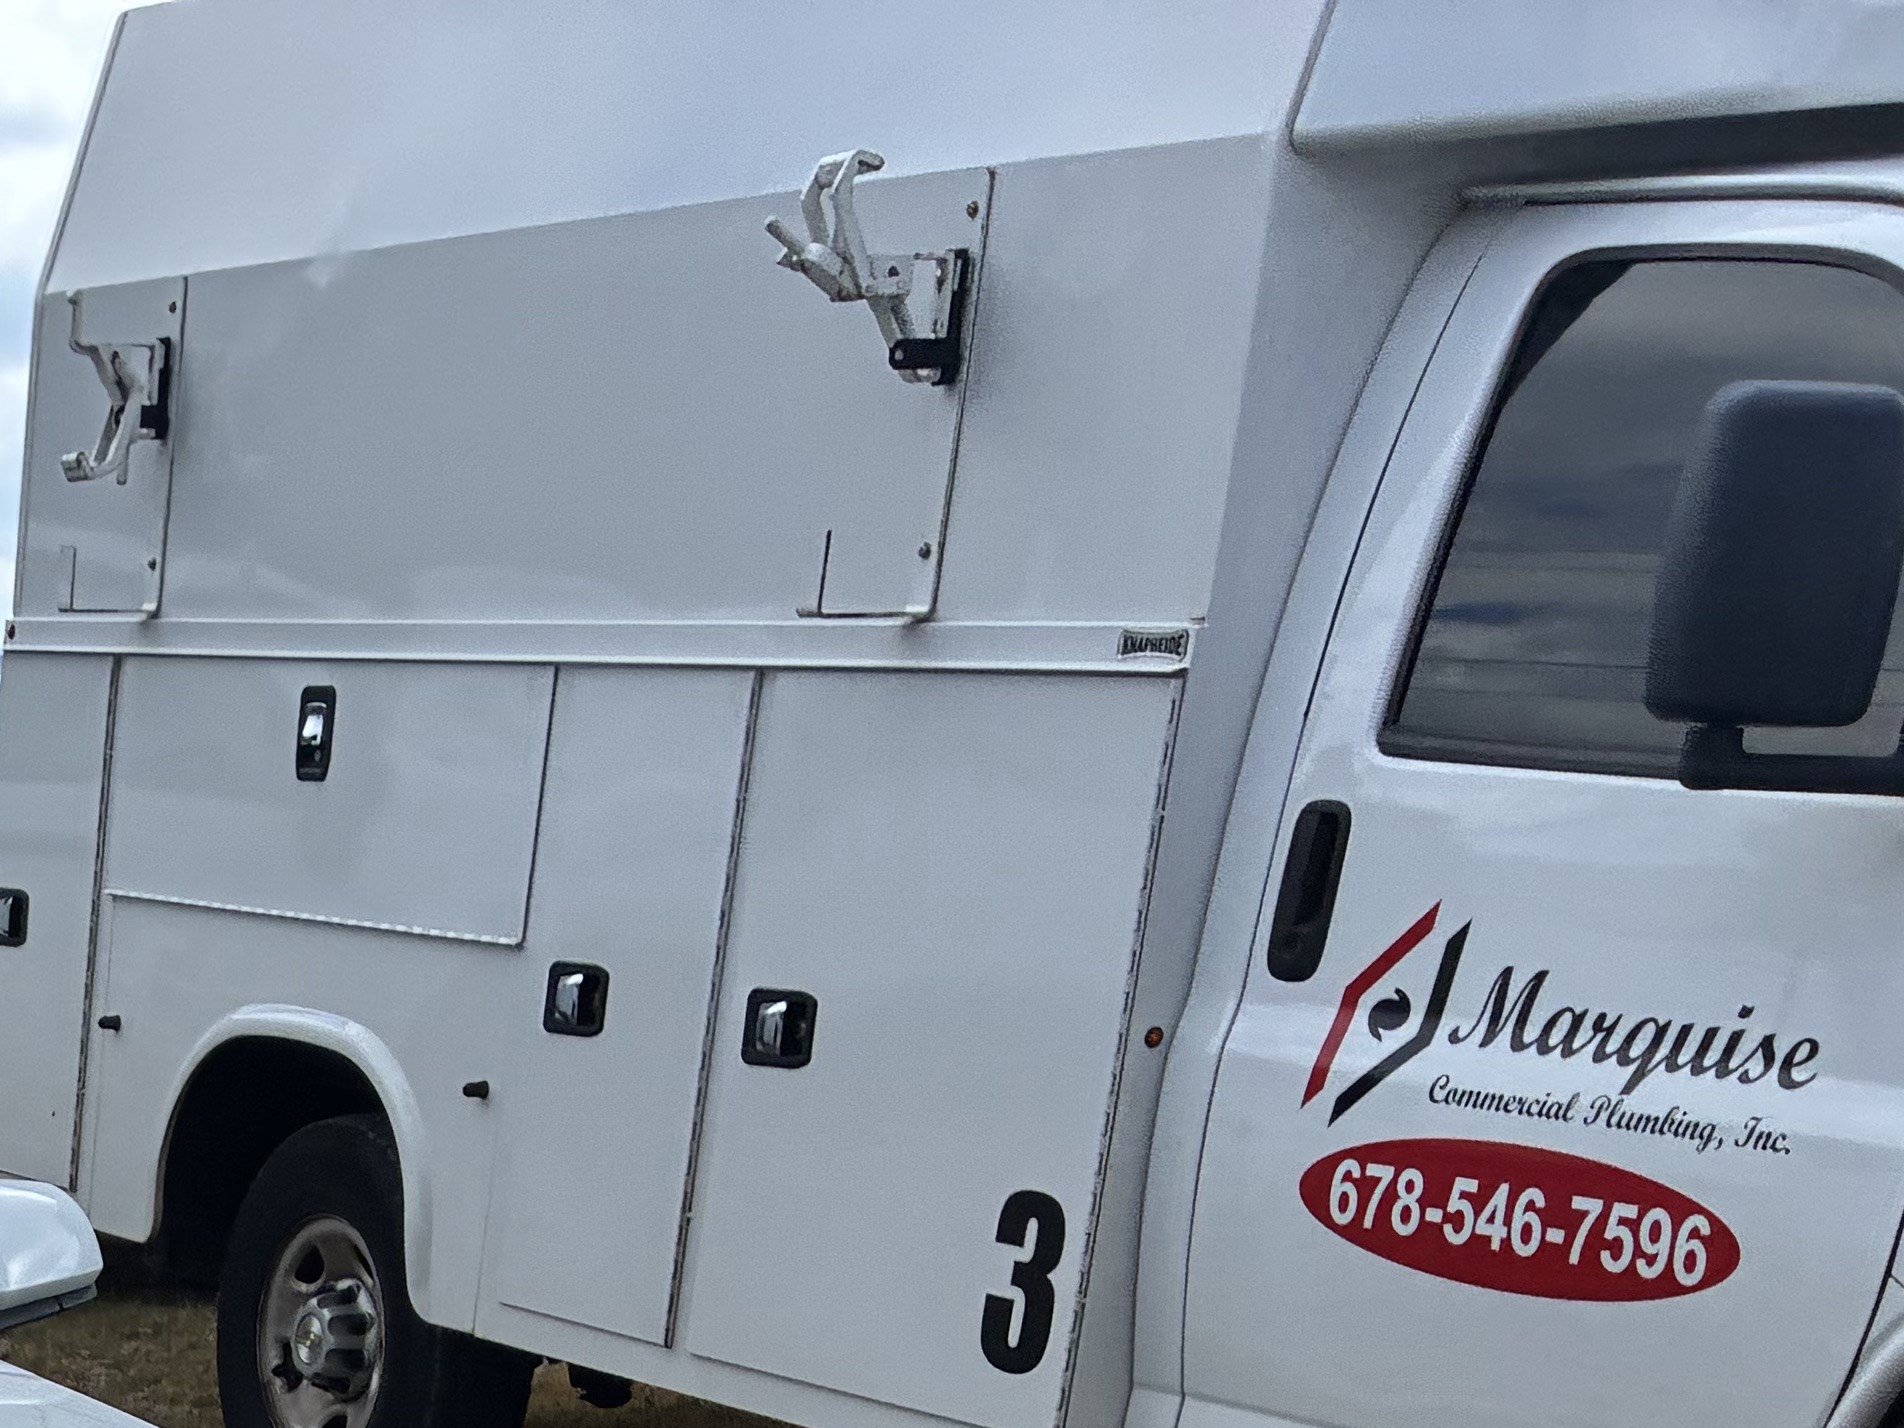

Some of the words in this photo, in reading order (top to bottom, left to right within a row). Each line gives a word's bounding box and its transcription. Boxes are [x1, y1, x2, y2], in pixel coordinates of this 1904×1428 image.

[1448, 965, 1821, 1096] Marquise
[1428, 1073, 1581, 1123] Commercial
[1583, 1094, 1725, 1154] Plumbing,
[1734, 1115, 1792, 1156] Inc.
[980, 1189, 1066, 1374] 3
[1328, 1158, 1711, 1287] 678-546-7596
